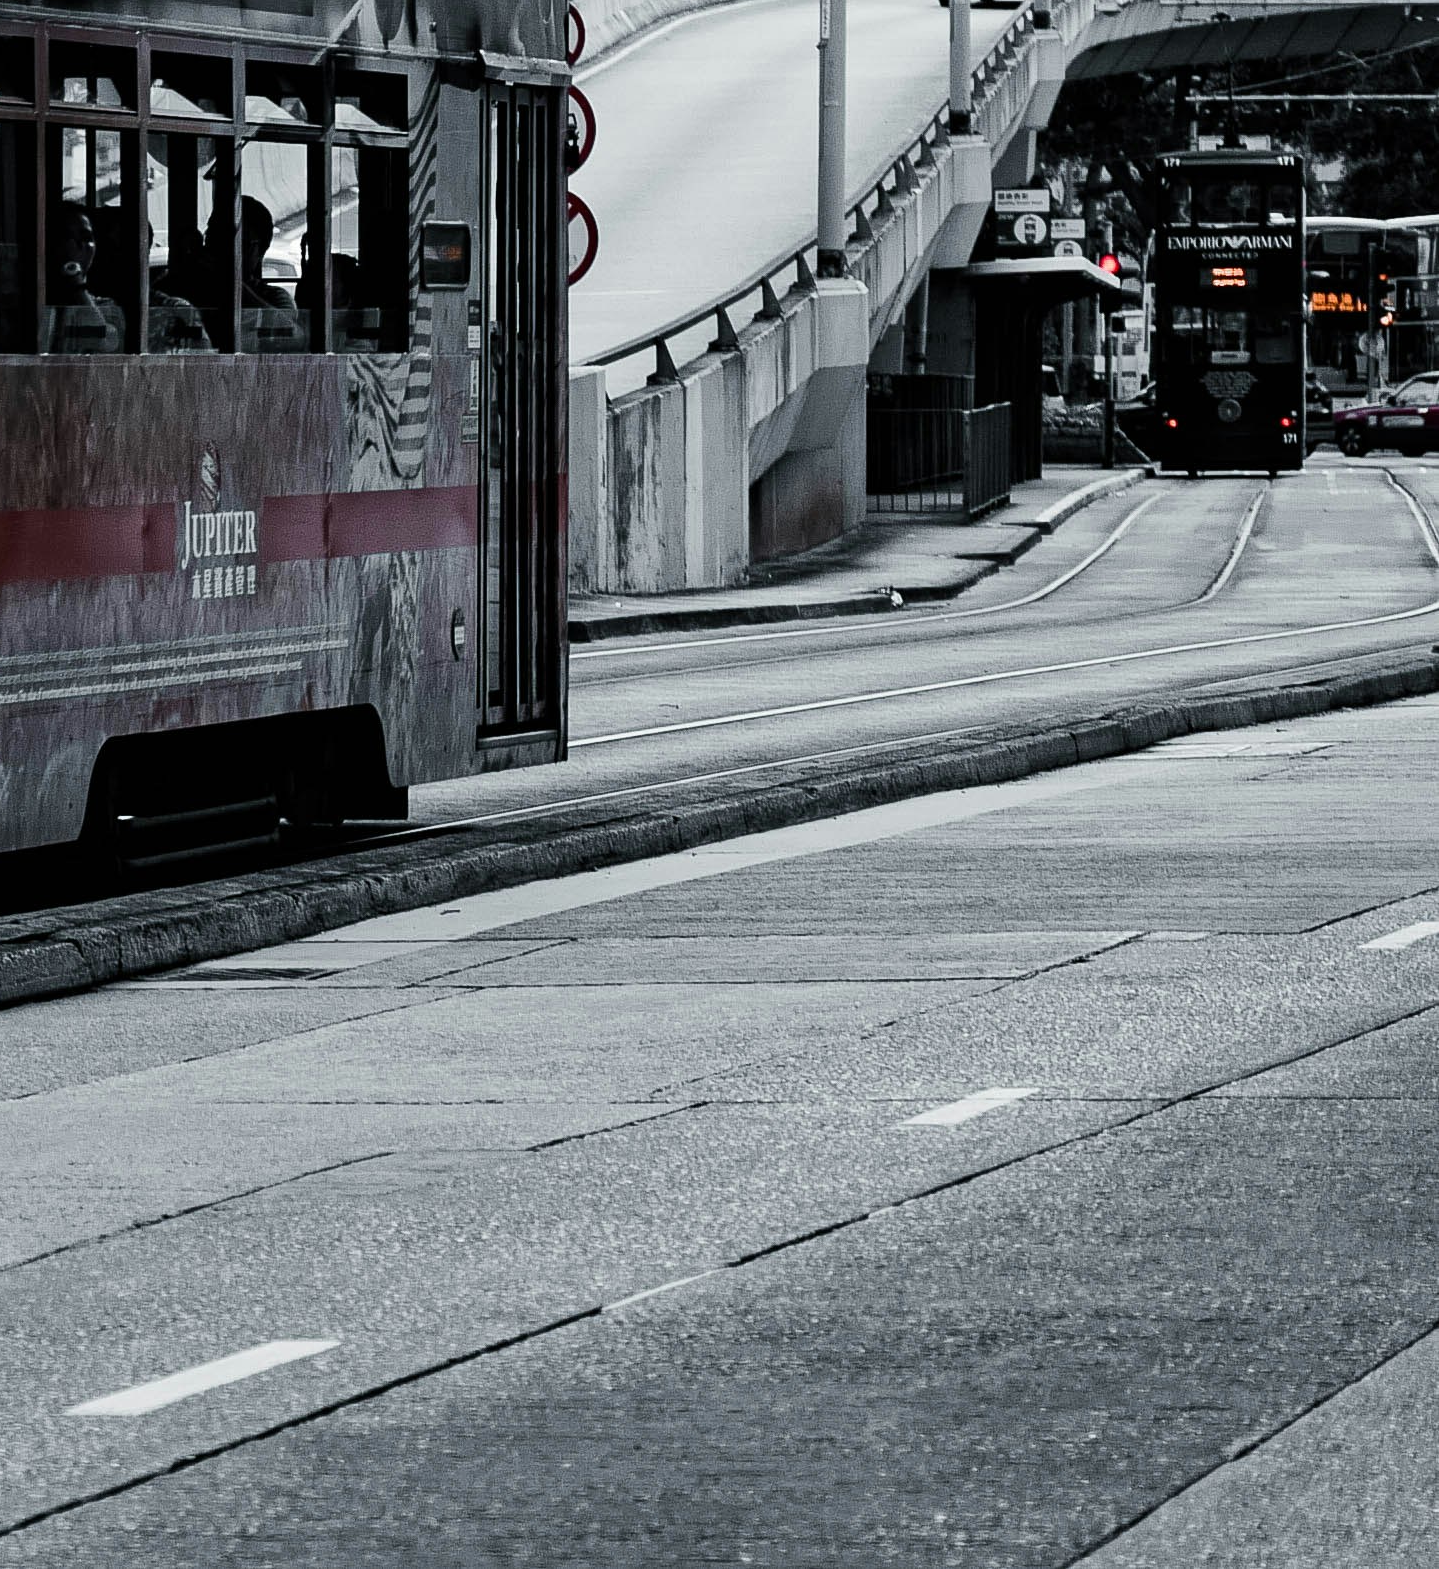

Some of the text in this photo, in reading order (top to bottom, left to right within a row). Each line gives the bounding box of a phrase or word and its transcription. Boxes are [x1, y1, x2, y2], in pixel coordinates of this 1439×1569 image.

[1168, 235, 1292, 250] EMPORIO ARMANI
[1283, 432, 1297, 444] 171
[182, 501, 257, 570] JUPITER
